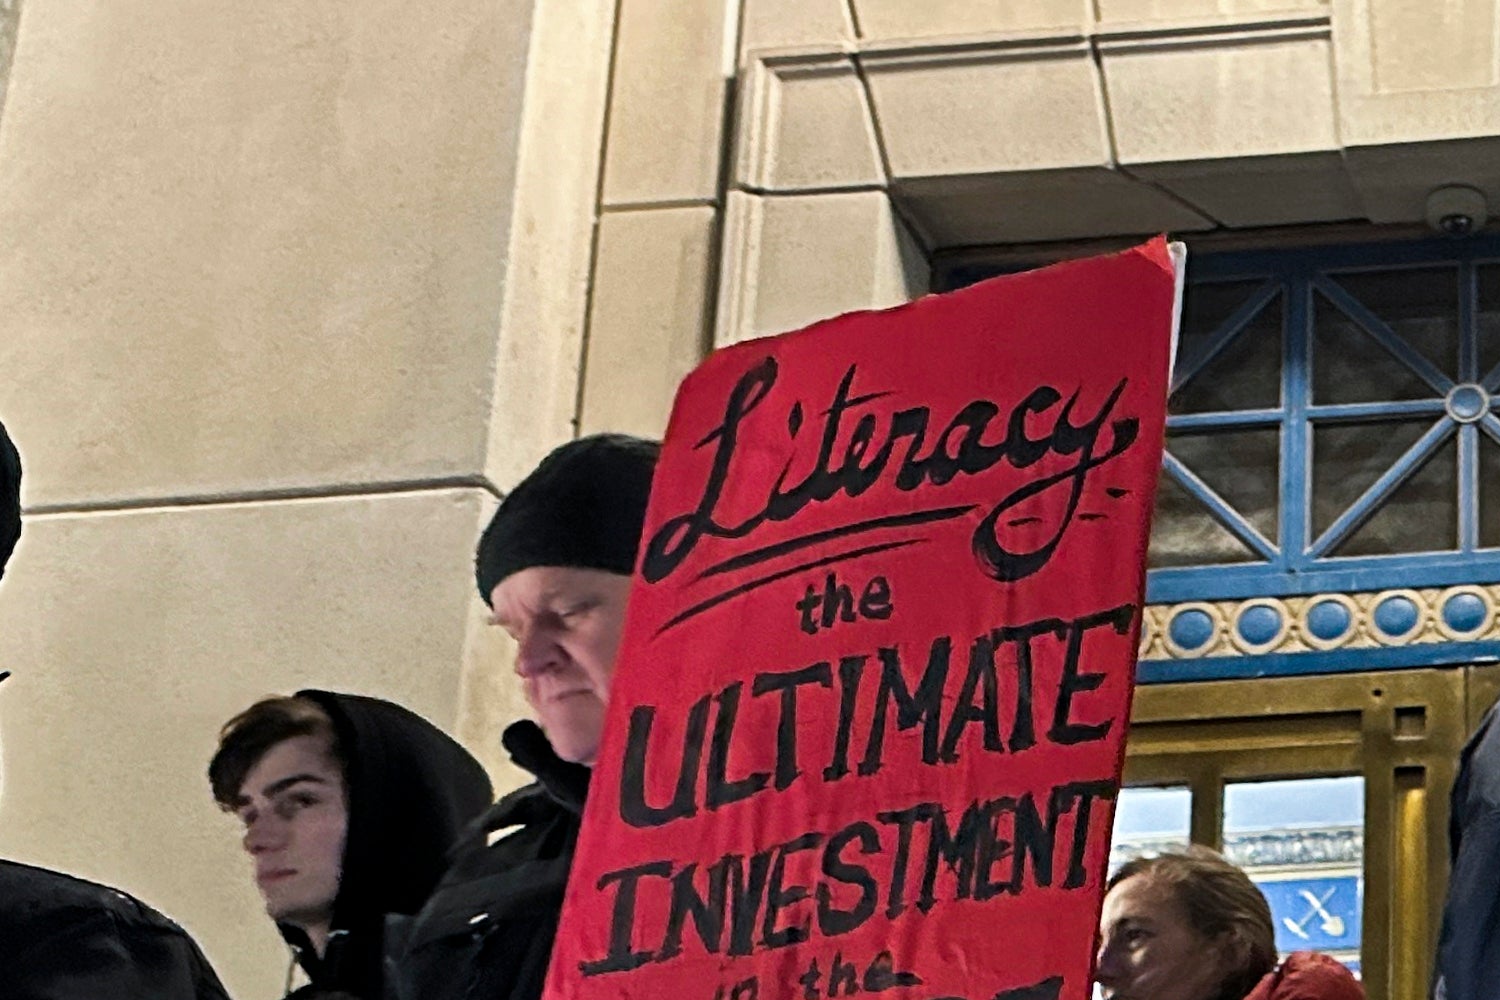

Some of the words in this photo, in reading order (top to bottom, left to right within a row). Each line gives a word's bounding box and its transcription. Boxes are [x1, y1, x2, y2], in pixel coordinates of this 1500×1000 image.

[796, 572, 894, 635] the
[619, 605, 1138, 828] ULTIMATE
[579, 778, 1120, 976] INVESTMENT
[799, 950, 922, 1000] the
